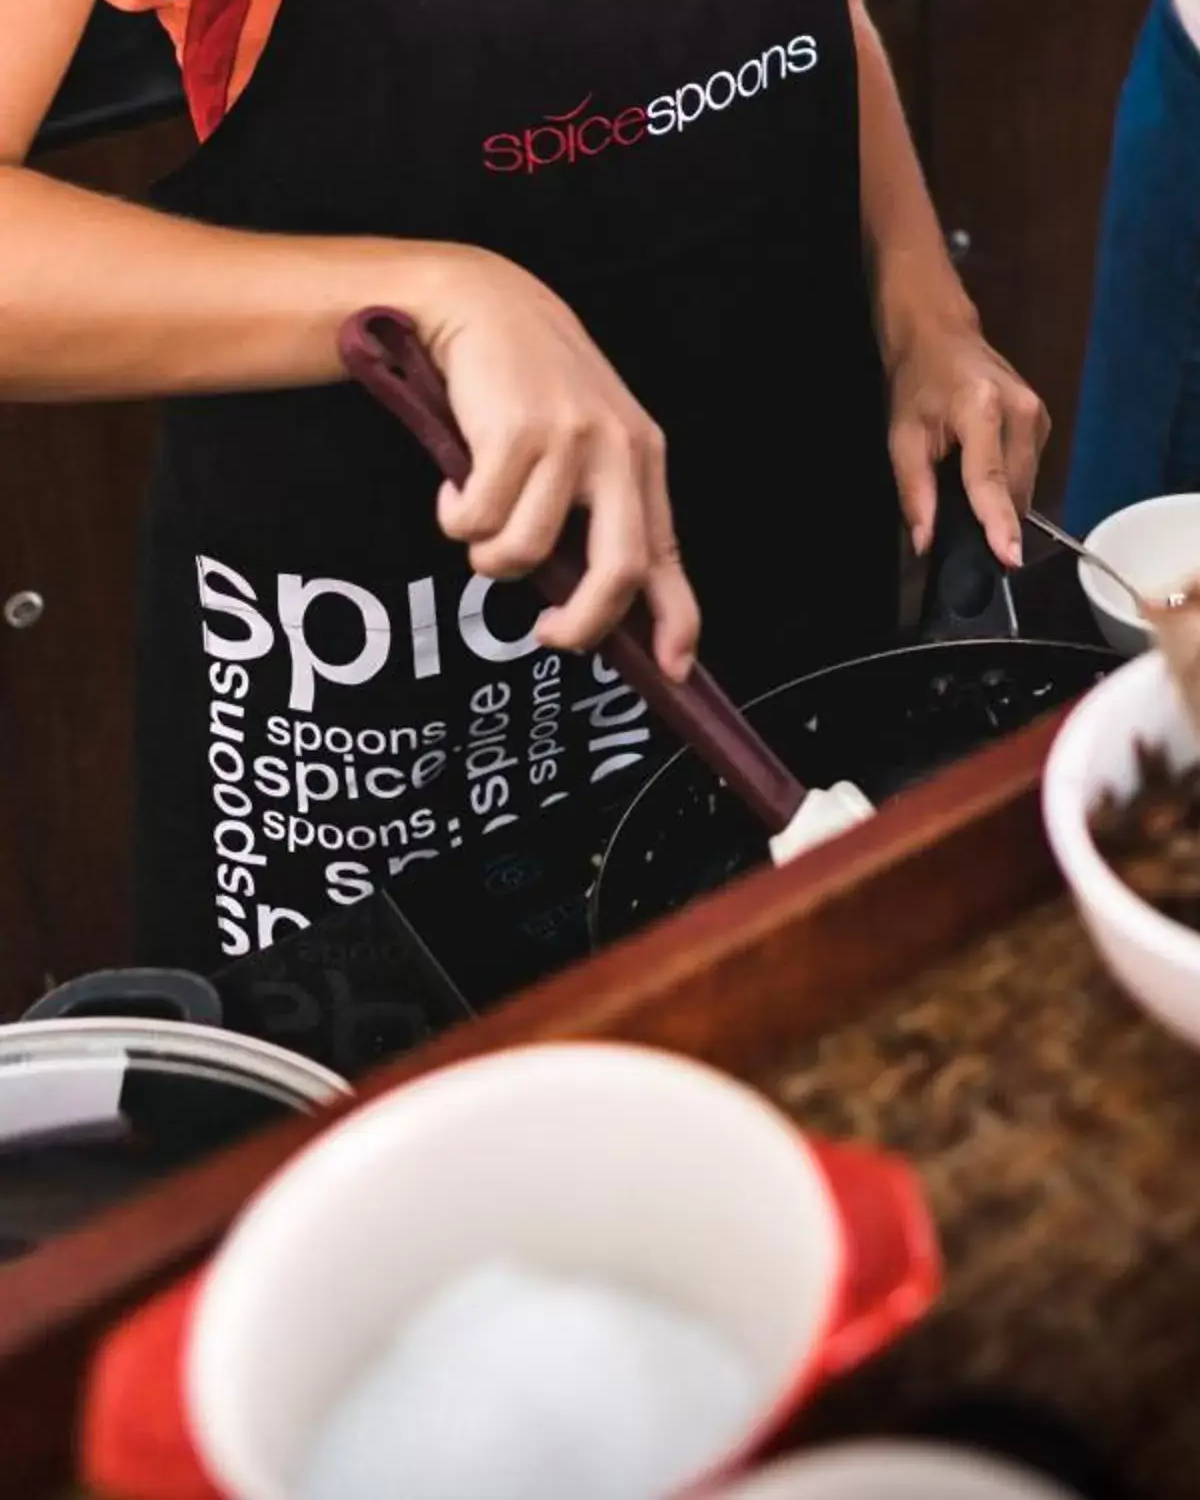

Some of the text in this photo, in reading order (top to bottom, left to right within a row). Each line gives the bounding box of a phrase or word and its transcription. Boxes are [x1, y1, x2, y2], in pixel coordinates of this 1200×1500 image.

[196, 555, 543, 712] spic
[207, 662, 267, 897] spoons
[254, 750, 446, 813] spice
[266, 715, 447, 756] spoons
[453, 681, 519, 815] spice
[526, 655, 566, 785] spoons
[263, 808, 436, 852] spoons
